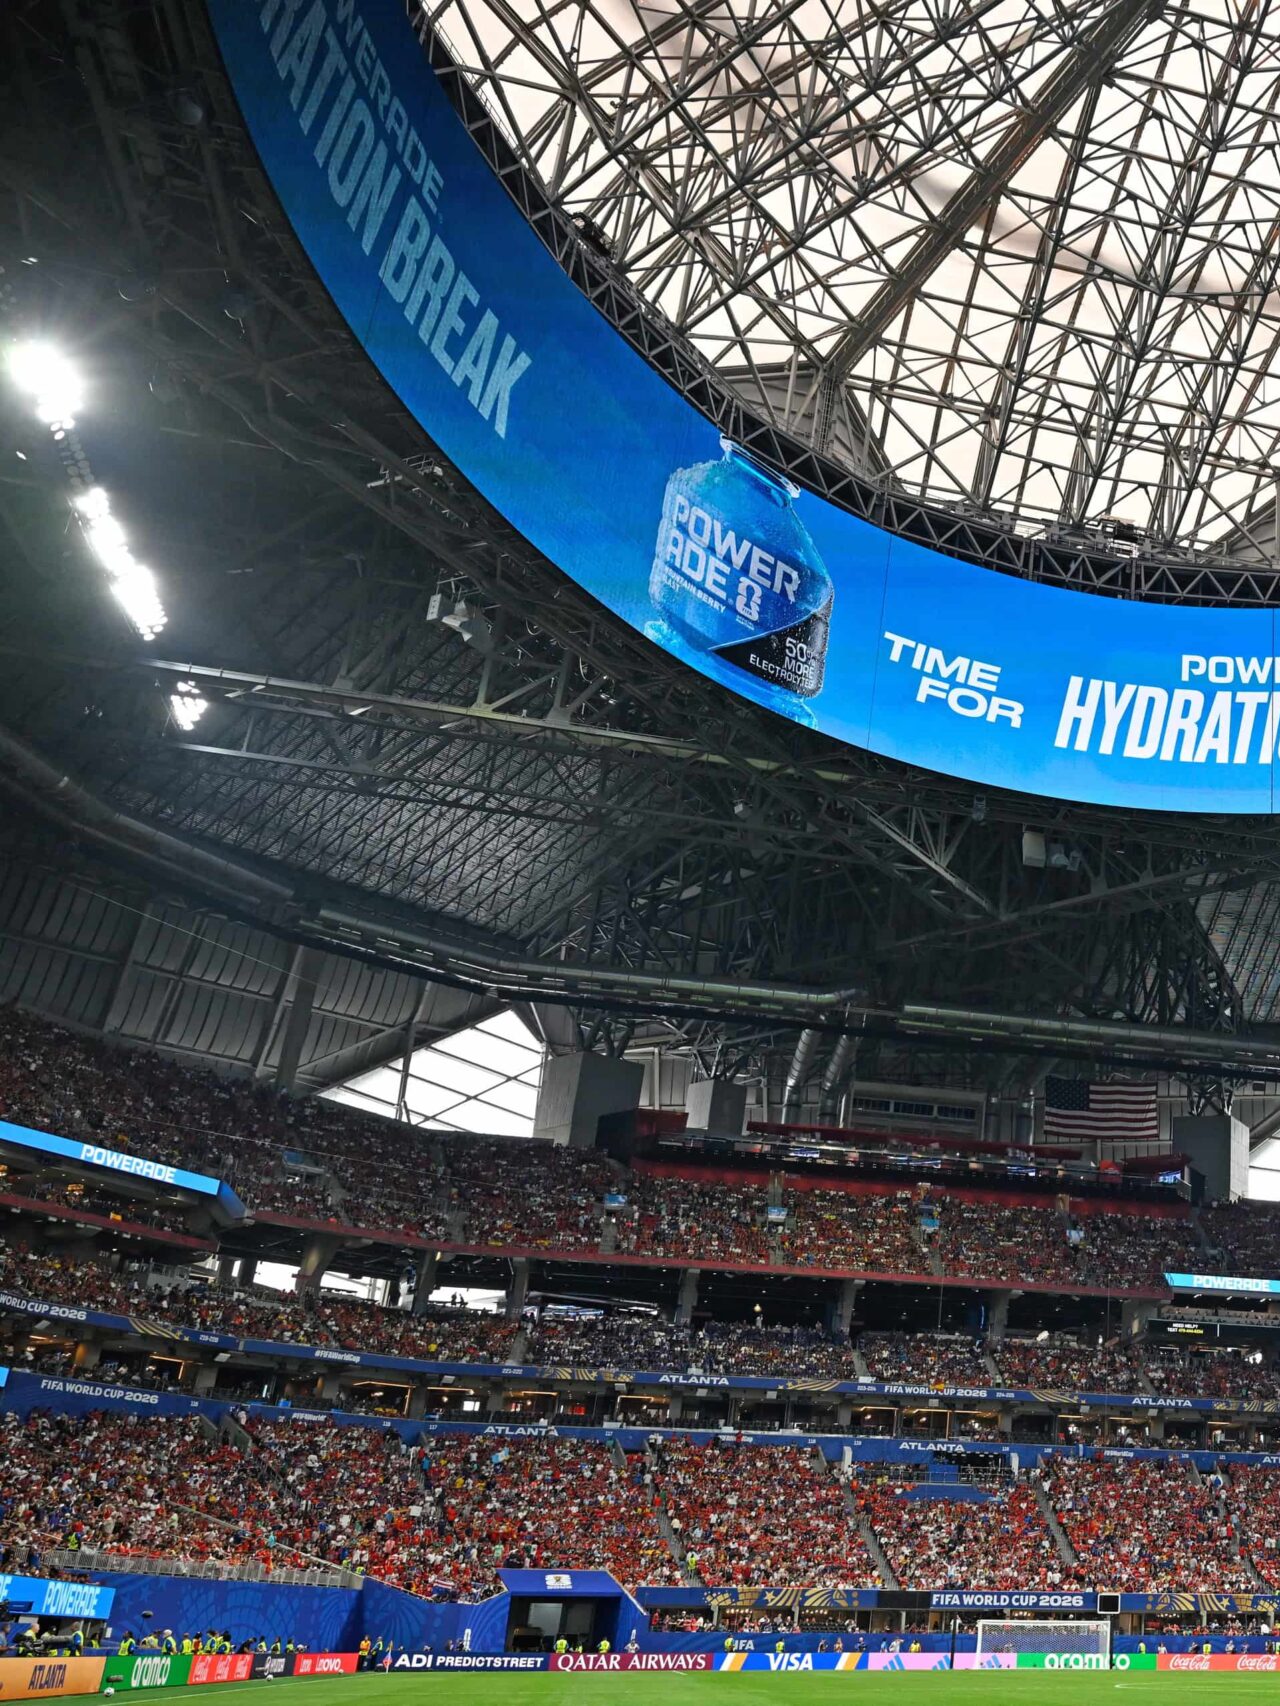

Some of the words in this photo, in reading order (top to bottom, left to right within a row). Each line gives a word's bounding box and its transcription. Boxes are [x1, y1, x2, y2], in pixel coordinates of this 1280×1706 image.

[379, 196, 532, 440] BREAK
[673, 495, 800, 604] POWER
[666, 528, 731, 601] ADE
[784, 656, 816, 680] MORE
[883, 631, 1002, 692] TIME
[915, 676, 1024, 729] FOR
[80, 1143, 177, 1183] POWERADE
[1192, 1275, 1271, 1293] POWERADE
[28, 1302, 50, 1315] CUP
[51, 1306, 88, 1321] 2026
[659, 1374, 729, 1386] ATLANTA
[41, 1379, 63, 1392] FIFA
[65, 1382, 103, 1397] WORLD
[103, 1388, 125, 1400] CUP
[124, 1391, 159, 1405] 2026
[884, 1385, 904, 1395] FIFA
[956, 1389, 988, 1398] 2026
[1132, 1397, 1193, 1407] ATLANTA
[899, 1441, 965, 1452] ATLANTA
[43, 1581, 100, 1617] POWERADE
[932, 1594, 960, 1606] FIFA
[961, 1594, 1011, 1607] WORLD
[1012, 1594, 1038, 1607] CUP
[1038, 1594, 1084, 1607] 2026
[733, 1639, 755, 1651] IFA
[395, 1654, 433, 1668] ADI
[436, 1655, 544, 1668] PREDICTSTREET
[557, 1654, 621, 1672] QATAR
[627, 1654, 707, 1670] AIRWAYS
[764, 1653, 813, 1671] VISA
[28, 1664, 67, 1690] ATLANTA
[131, 1657, 171, 1688] aramco
